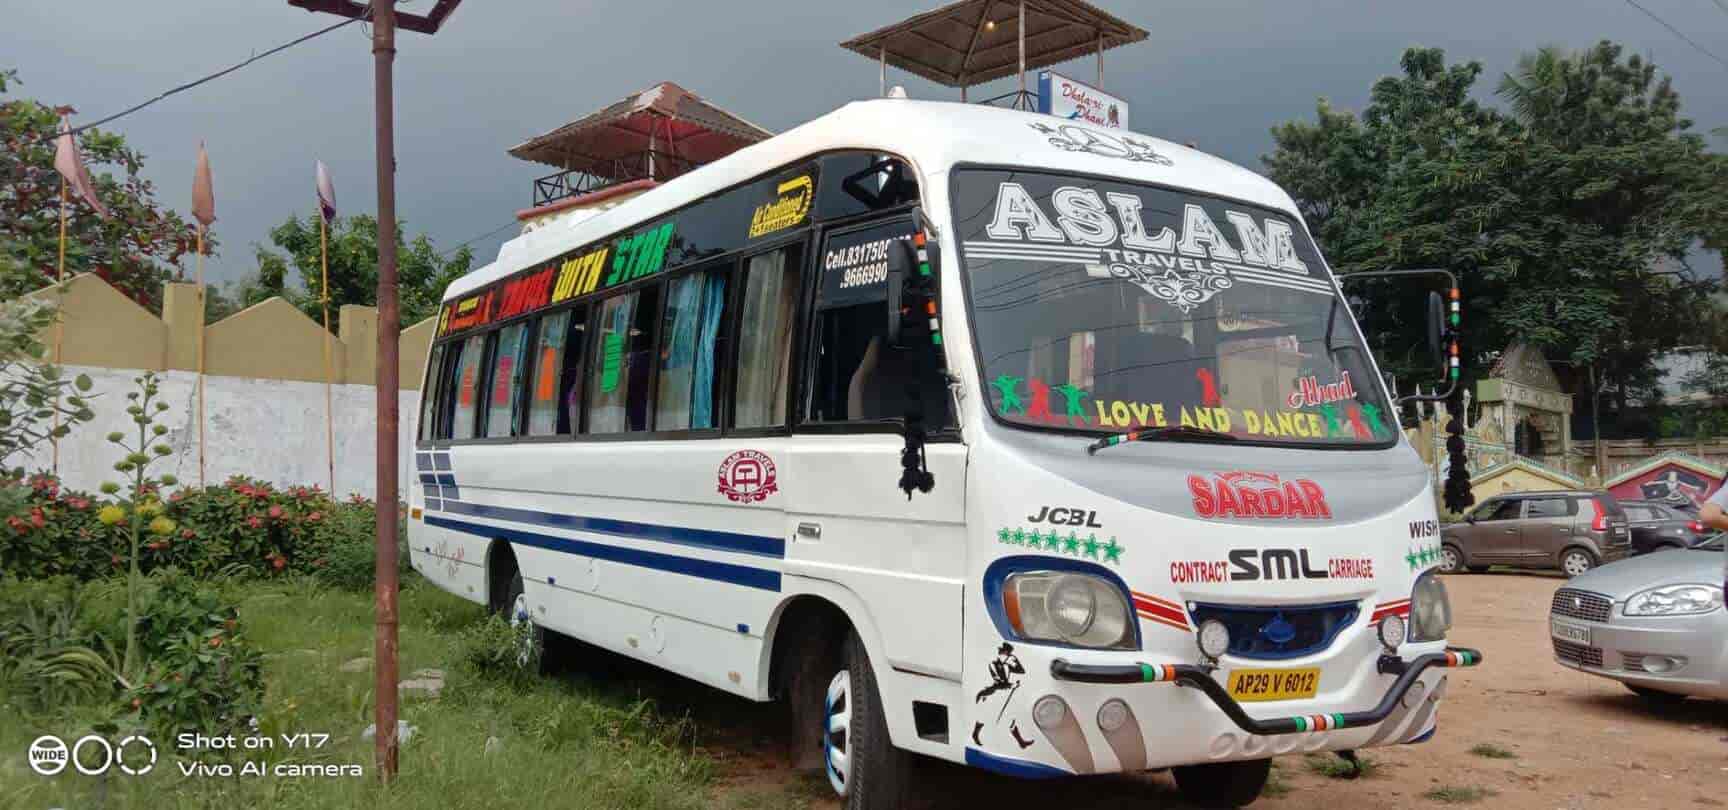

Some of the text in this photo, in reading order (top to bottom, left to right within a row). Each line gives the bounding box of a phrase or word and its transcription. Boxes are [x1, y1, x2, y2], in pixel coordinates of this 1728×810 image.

[986, 182, 1308, 274] ASLAM
[826, 234, 912, 271] Cell.831750
[1104, 249, 1227, 276] TRAVELS
[1095, 398, 1323, 439] LOVE AND DANCE
[1186, 470, 1334, 520] SARDAR
[1027, 505, 1102, 529] JCBL
[1408, 519, 1438, 539] WISH
[1169, 548, 1374, 585] CONTRACT SML CARRIAGE
[1234, 673, 1315, 694] AP29 V 6012
